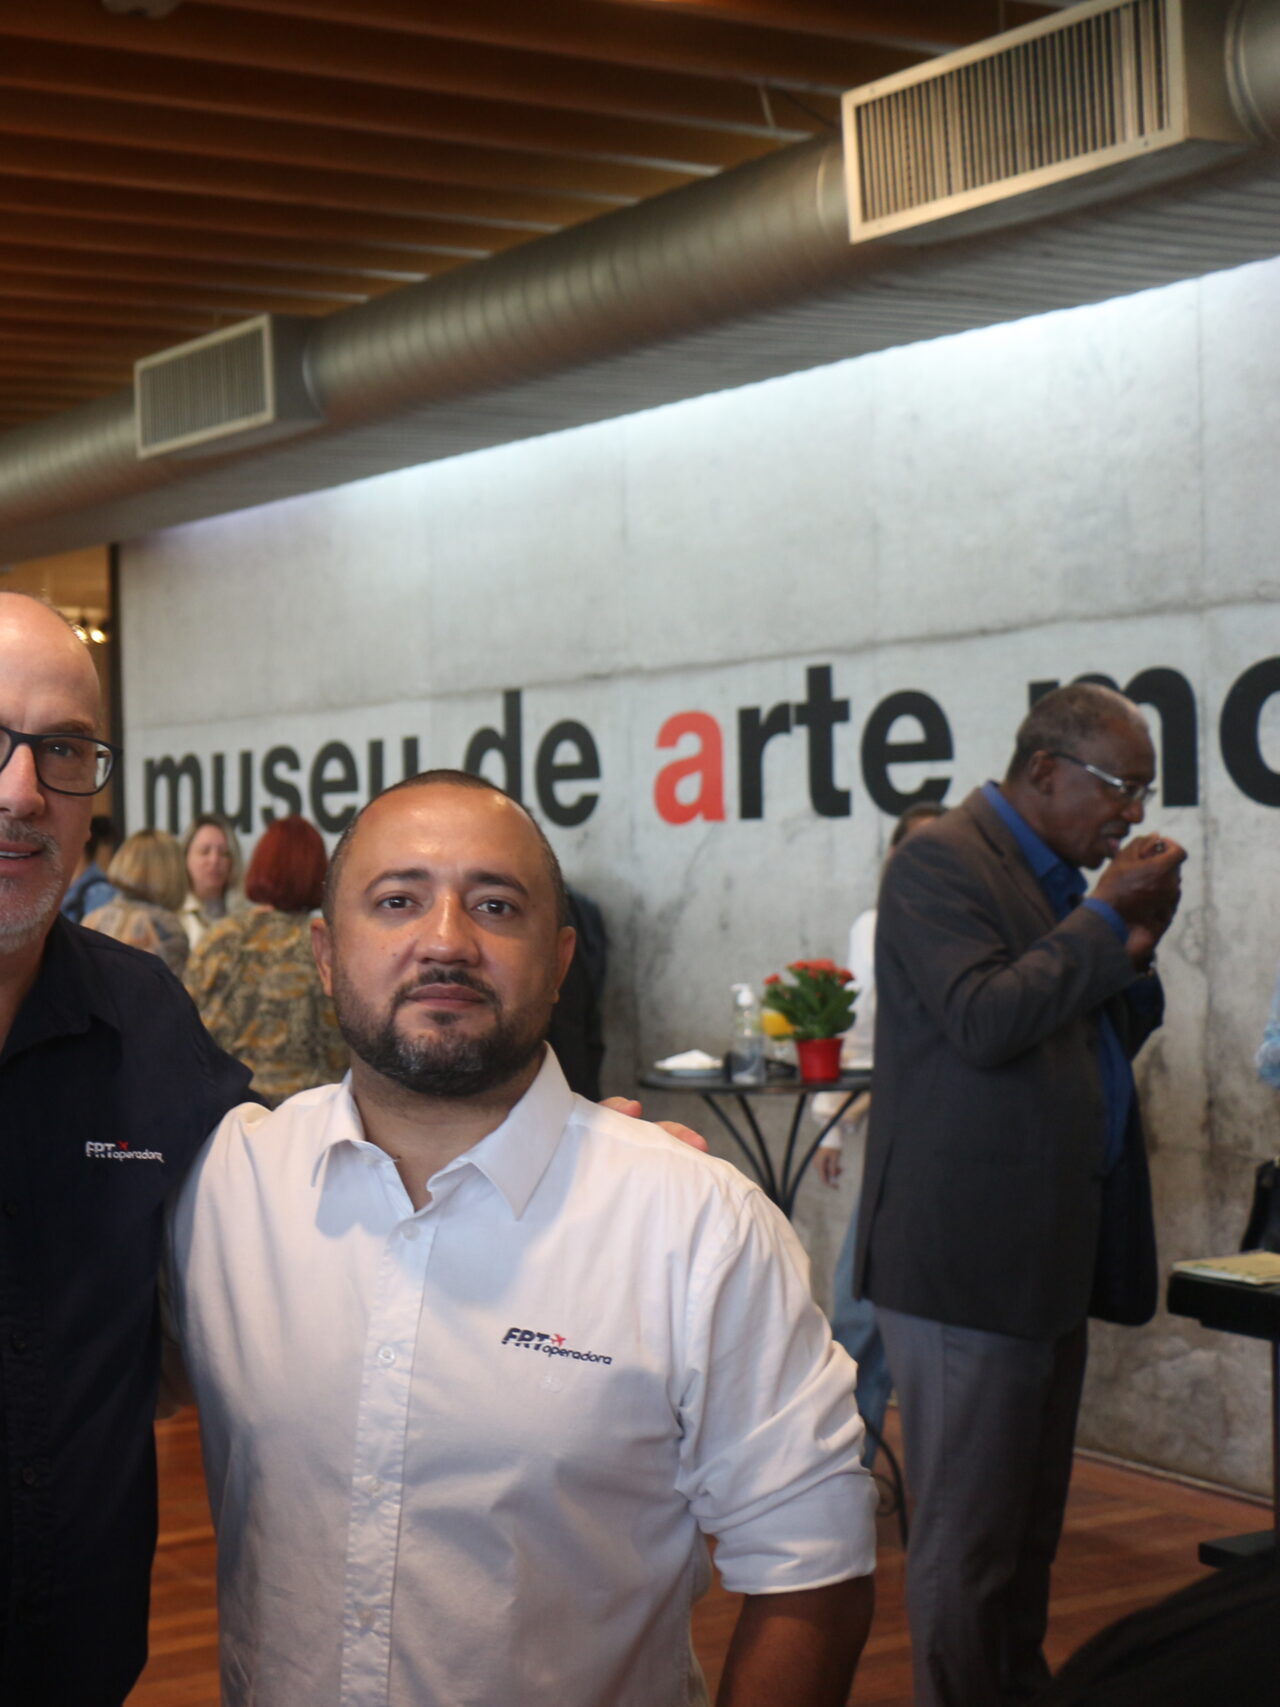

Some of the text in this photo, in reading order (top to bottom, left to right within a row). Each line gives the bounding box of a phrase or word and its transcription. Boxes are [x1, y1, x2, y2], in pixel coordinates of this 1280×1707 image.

[463, 690, 601, 828] de
[653, 664, 954, 825] arte
[113, 1149, 165, 1163] operadora
[542, 1345, 613, 1365] operadora
